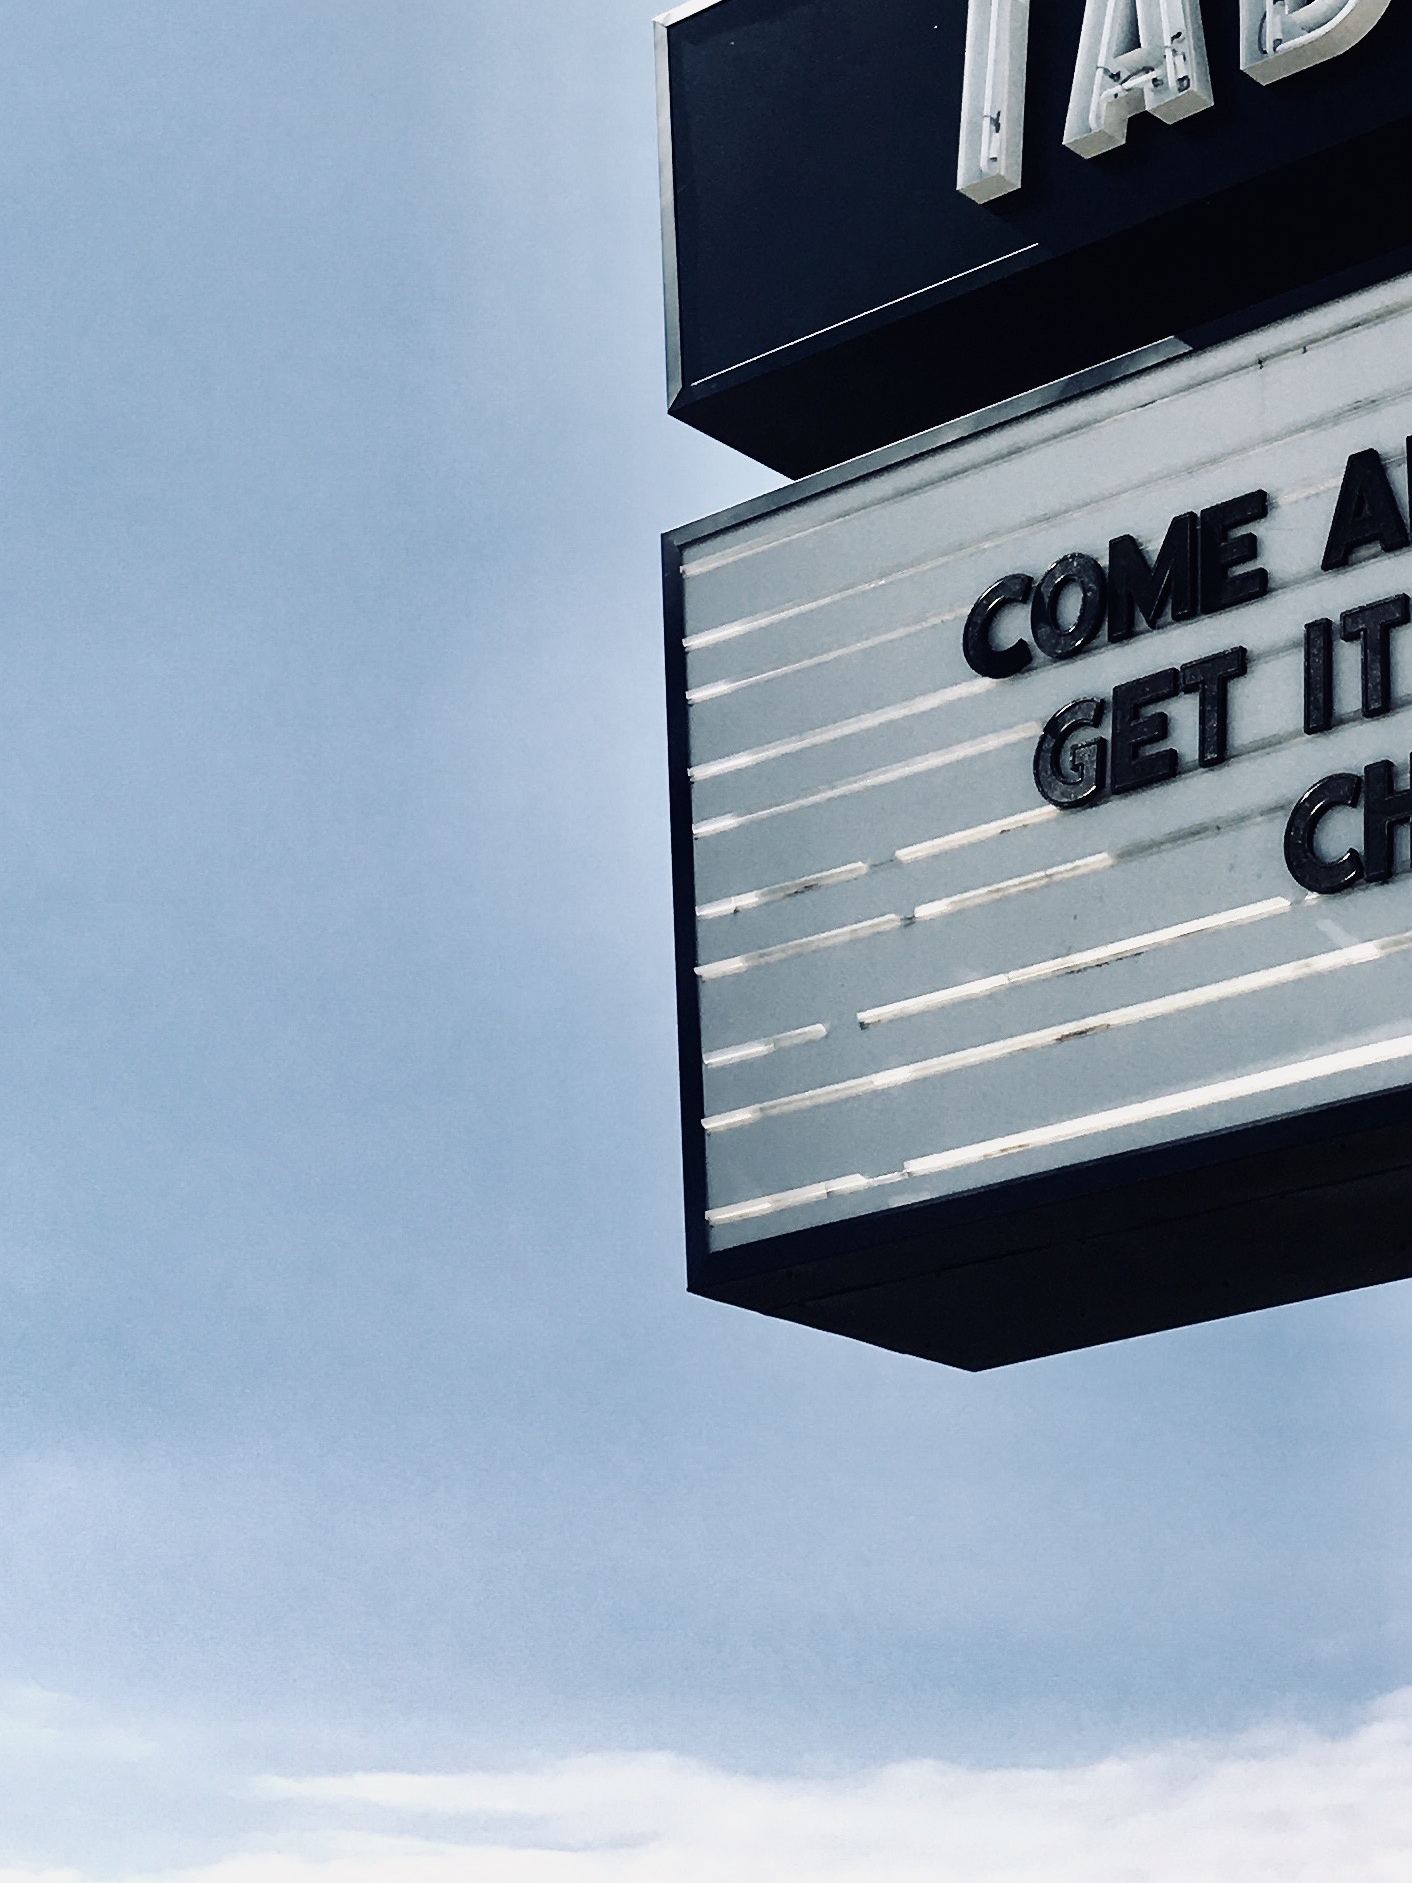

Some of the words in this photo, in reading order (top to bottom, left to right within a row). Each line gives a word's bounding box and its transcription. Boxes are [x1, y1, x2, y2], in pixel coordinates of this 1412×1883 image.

[962, 489, 1268, 679] COME
[1033, 645, 1247, 809] GET
[1303, 593, 1411, 735] IT
